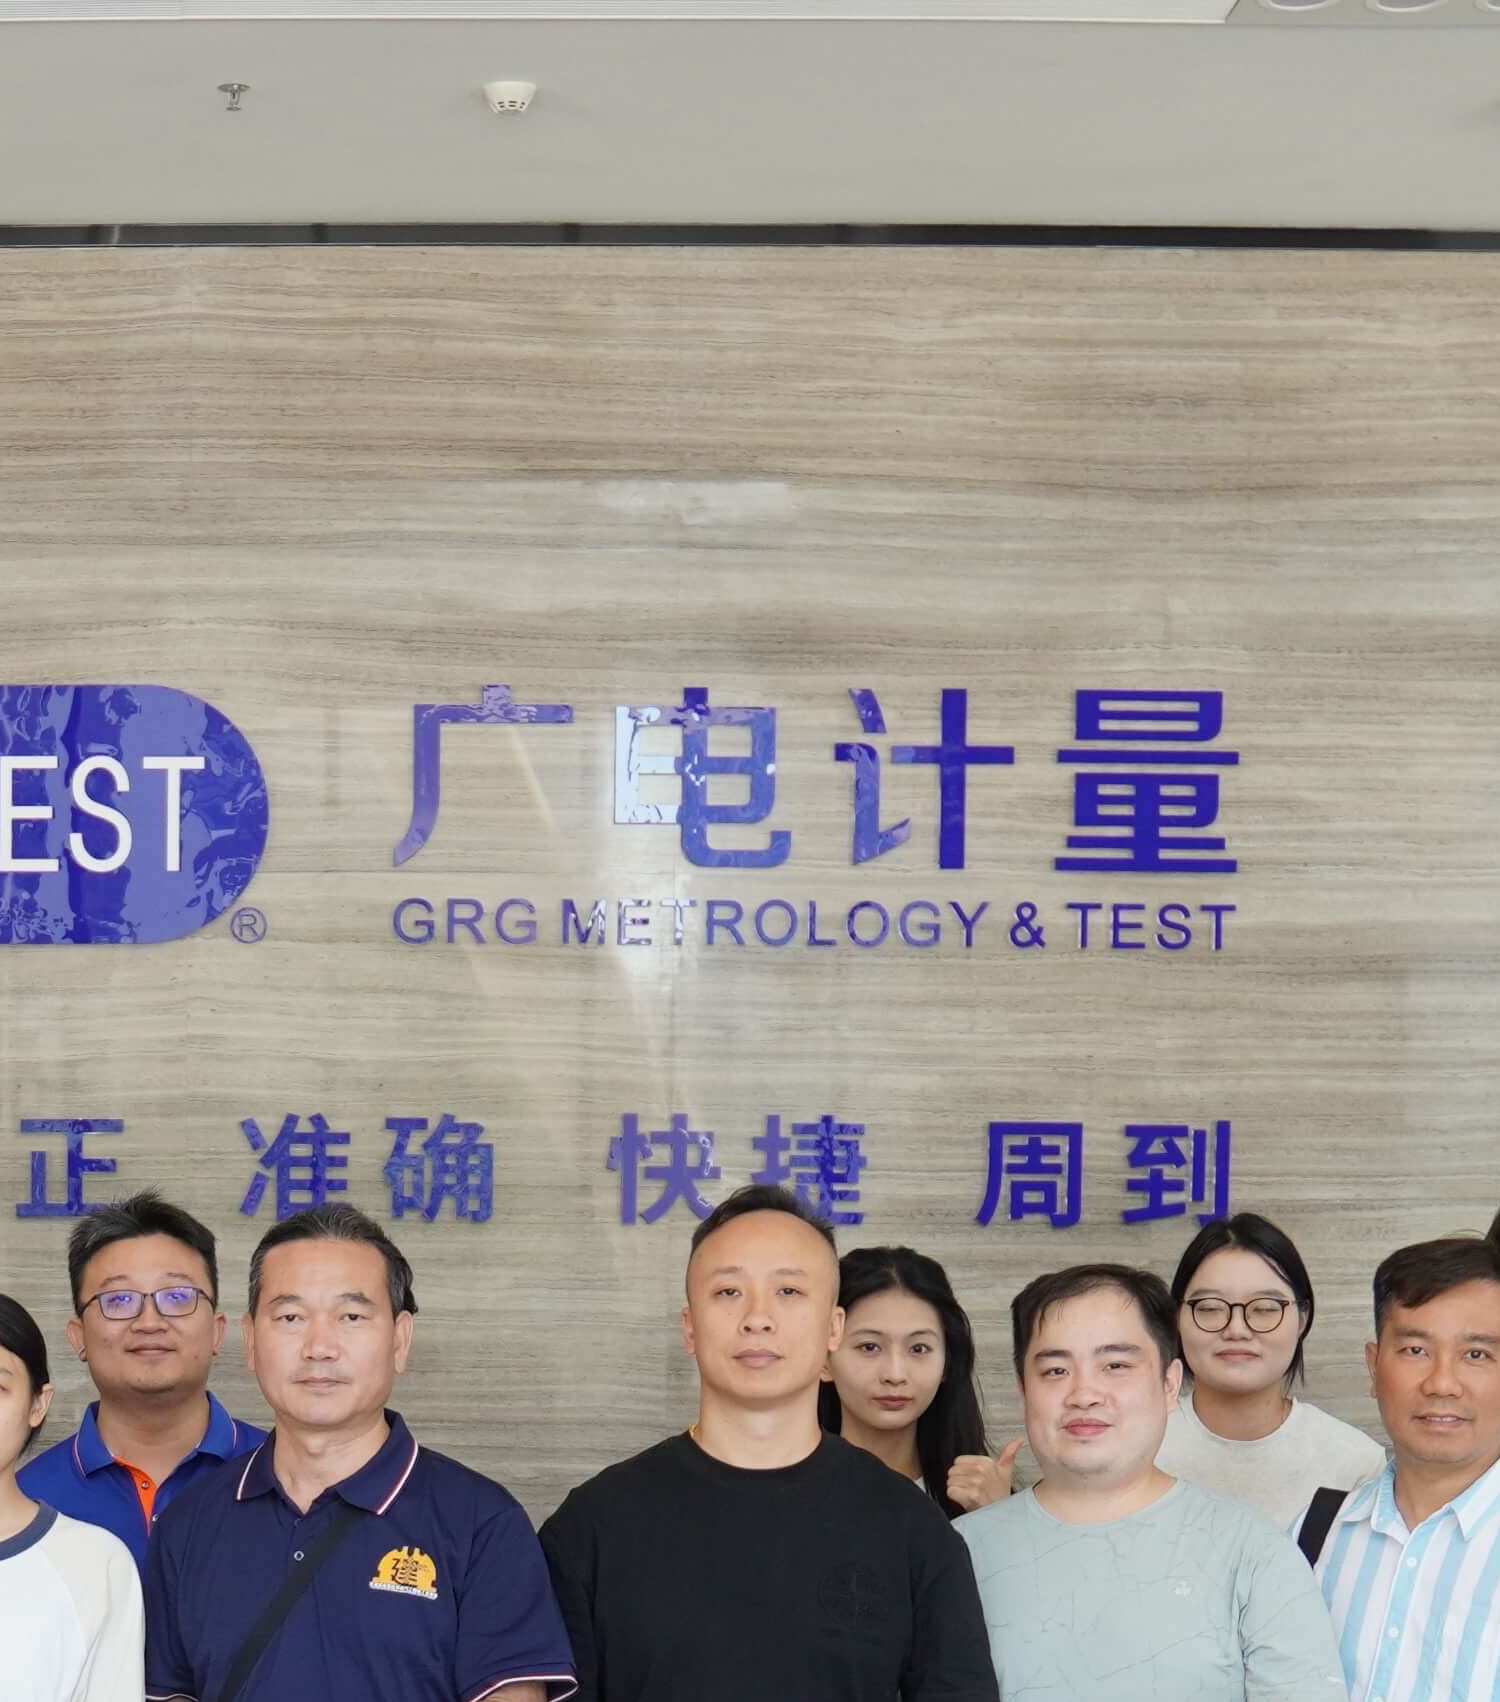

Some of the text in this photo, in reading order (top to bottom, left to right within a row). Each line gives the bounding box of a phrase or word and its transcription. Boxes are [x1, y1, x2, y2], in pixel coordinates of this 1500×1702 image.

[392, 684, 1240, 874] 广电计量
[392, 897, 1238, 952] GRG METROLOGY & TEST
[239, 1112, 495, 1224] 准确
[608, 1112, 869, 1227] 快捷
[976, 1118, 1233, 1228] 周到
